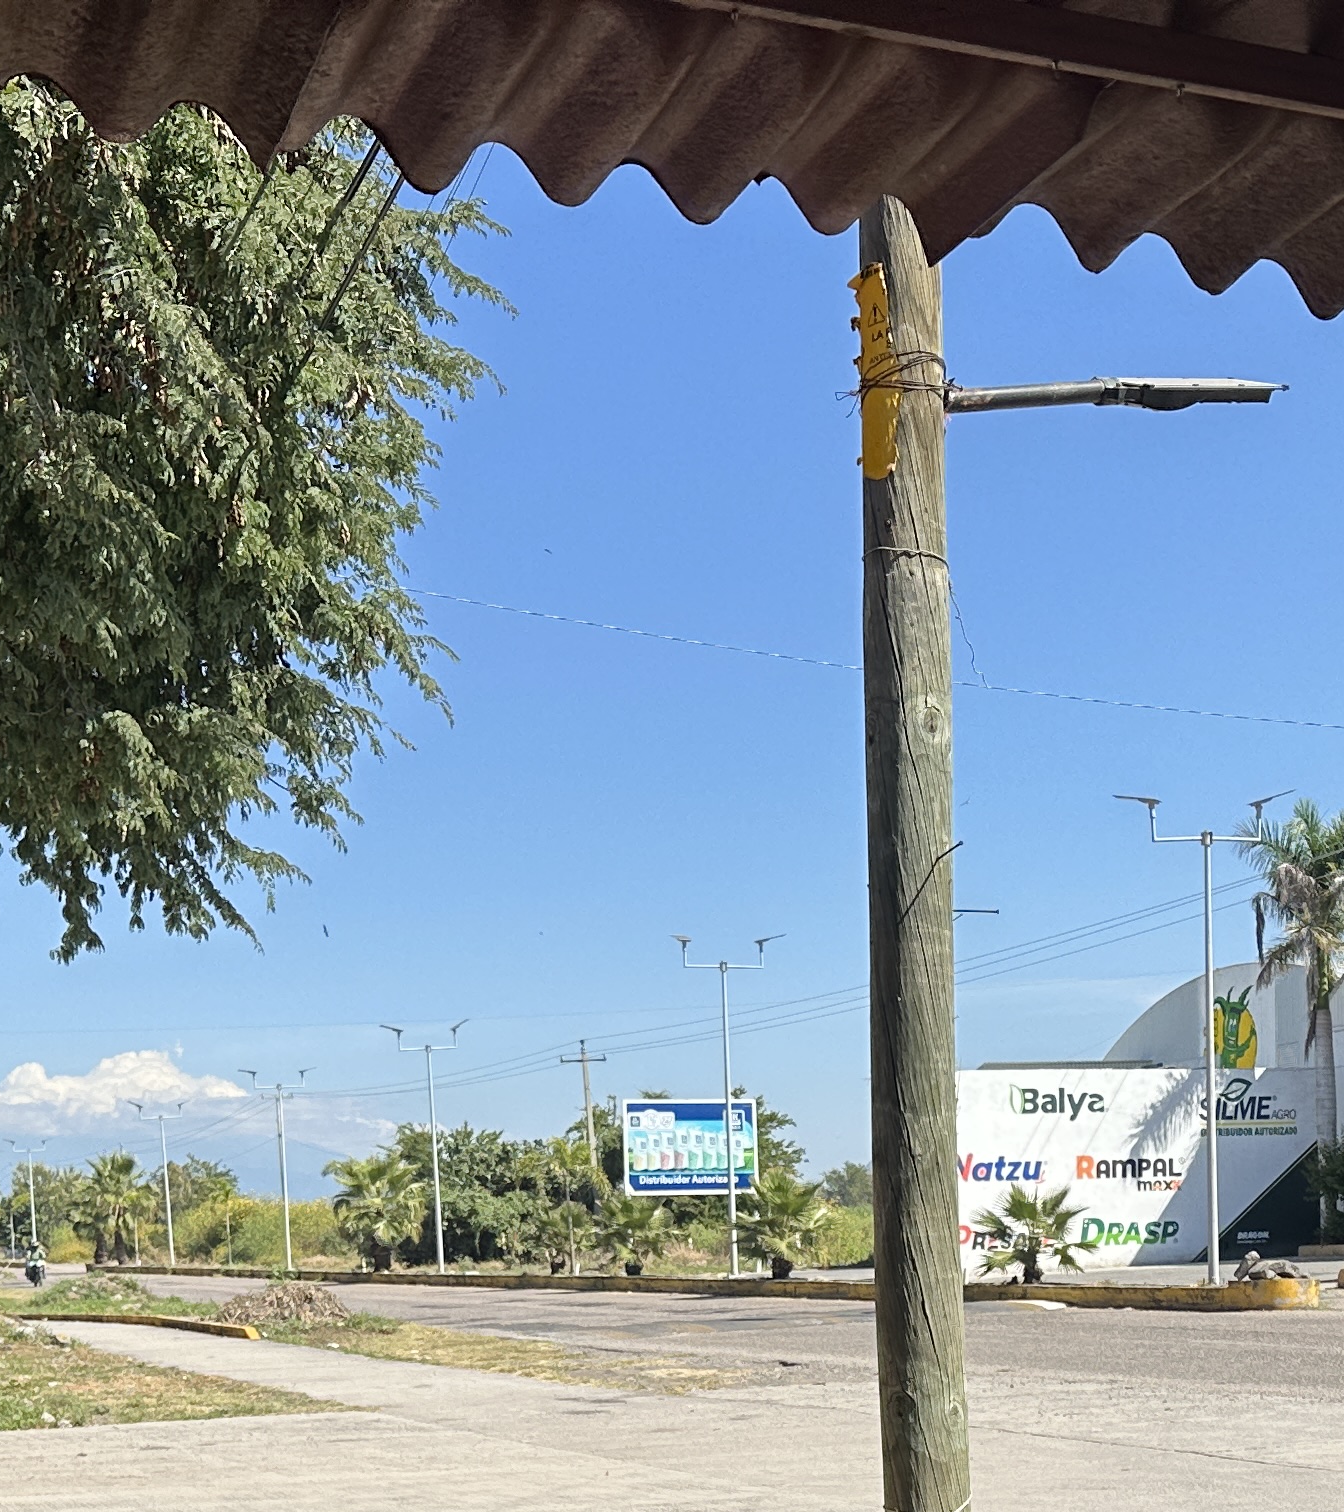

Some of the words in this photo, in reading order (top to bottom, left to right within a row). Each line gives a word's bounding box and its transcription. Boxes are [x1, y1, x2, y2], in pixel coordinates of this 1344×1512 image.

[1020, 1087, 1105, 1122] Balya
[639, 1175, 691, 1185] Distribuidor
[691, 1174, 739, 1184] Autorizao
[1081, 1217, 1180, 1246] DRASP
